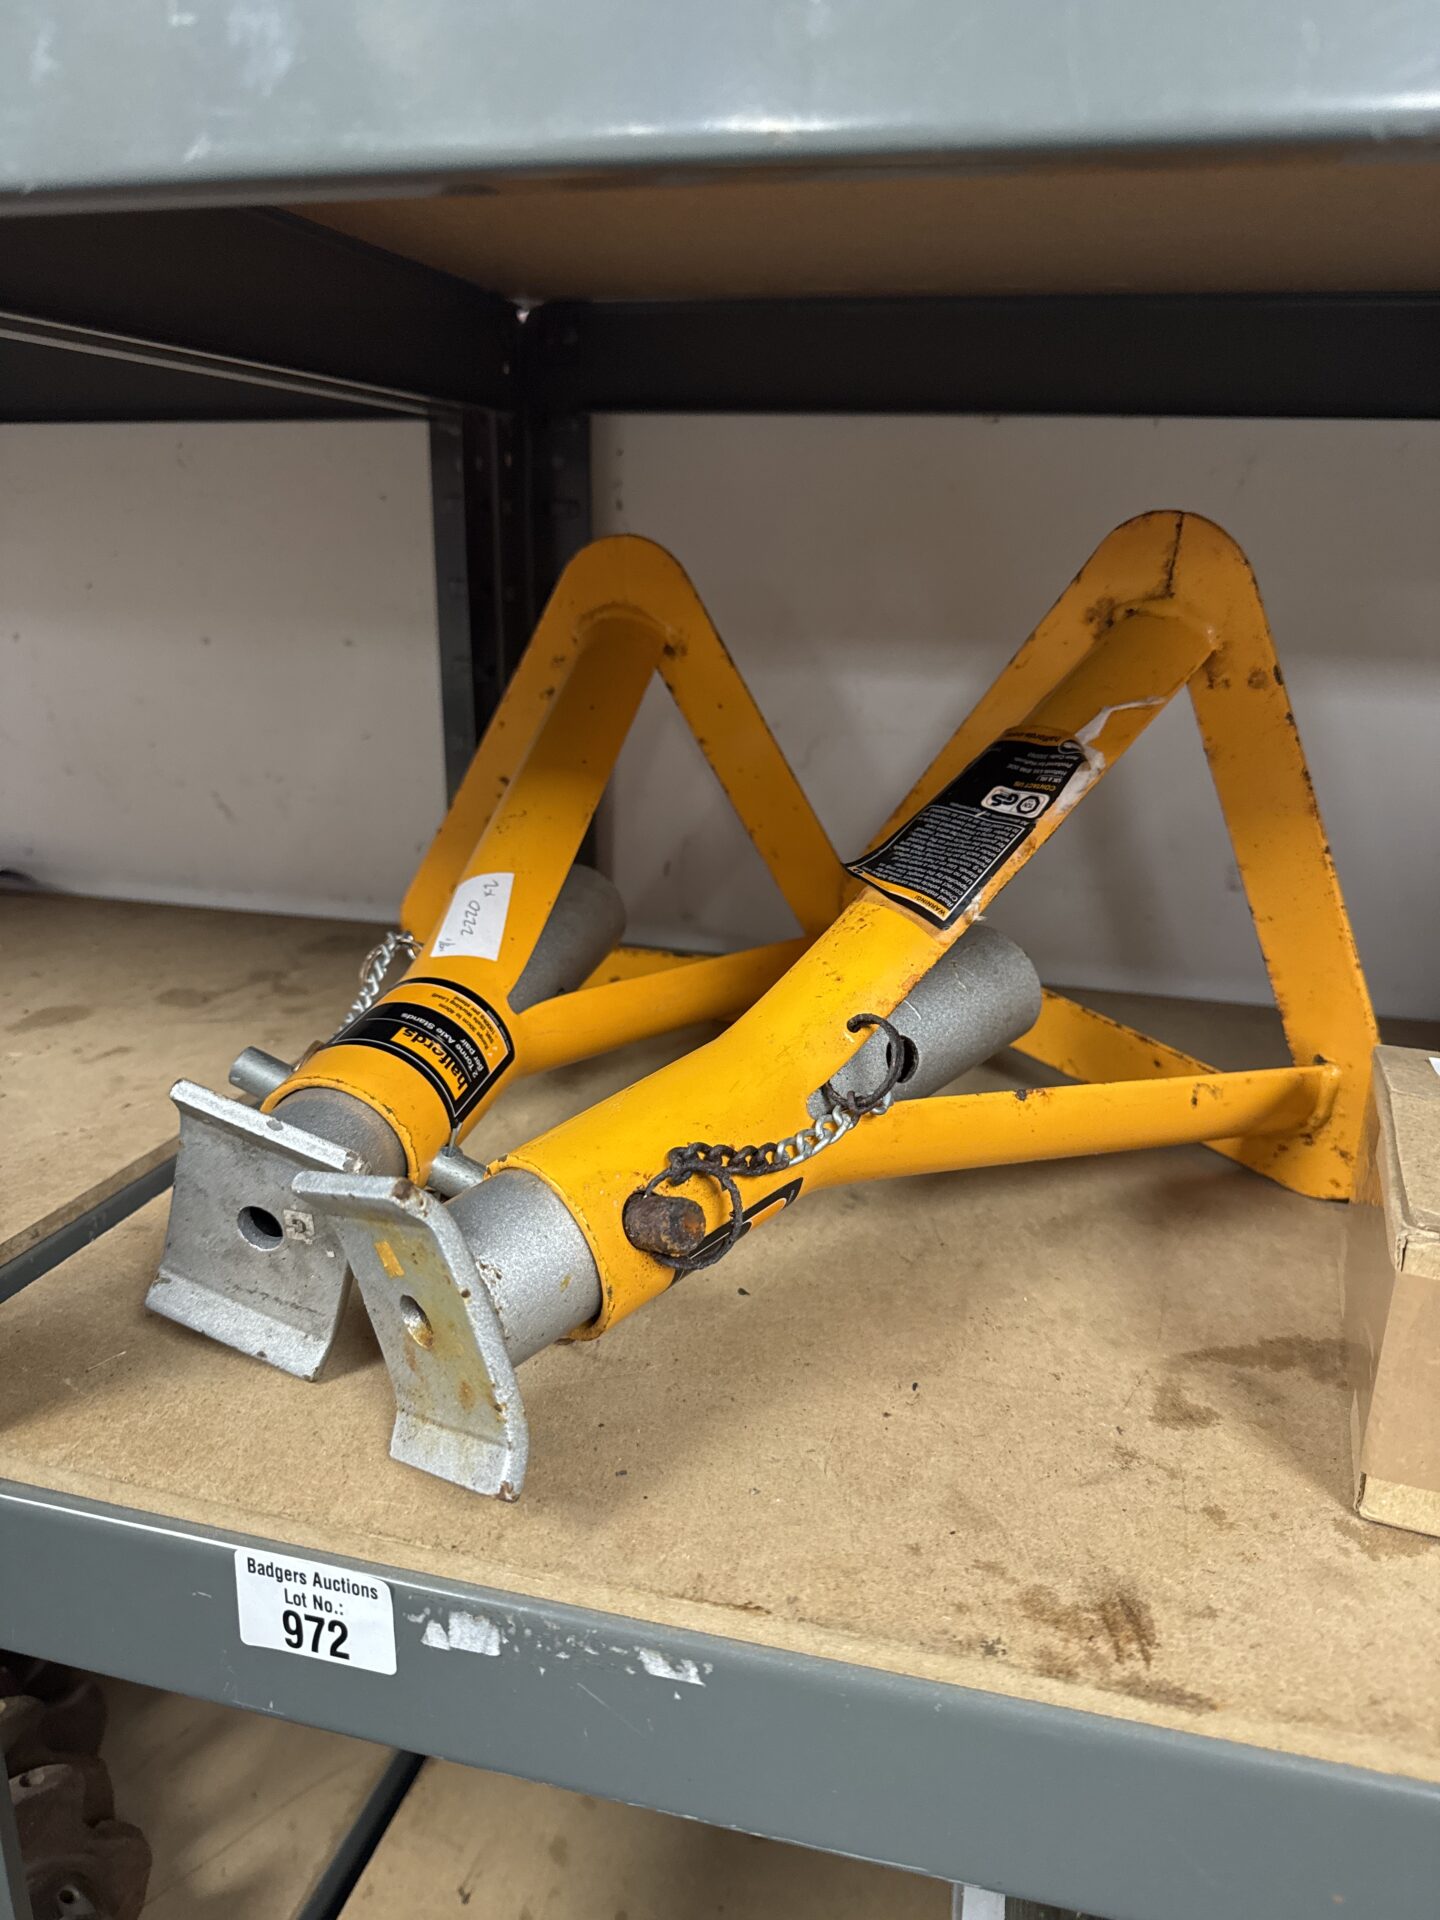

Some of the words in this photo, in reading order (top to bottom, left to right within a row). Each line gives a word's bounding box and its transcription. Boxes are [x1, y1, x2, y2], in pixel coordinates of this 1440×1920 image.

[401, 1012, 436, 1030] Stands
[435, 1027, 456, 1044] Axle
[460, 1039, 476, 1055] pair
[401, 1026, 466, 1090] halfords
[455, 1043, 474, 1070] Tonne
[471, 1069, 479, 1078] 2
[247, 1557, 307, 1585] Badgers
[313, 1572, 378, 1600] Auctions
[284, 1588, 307, 1608] Lot
[312, 1594, 344, 1615] No.:
[282, 1609, 350, 1660] 972
